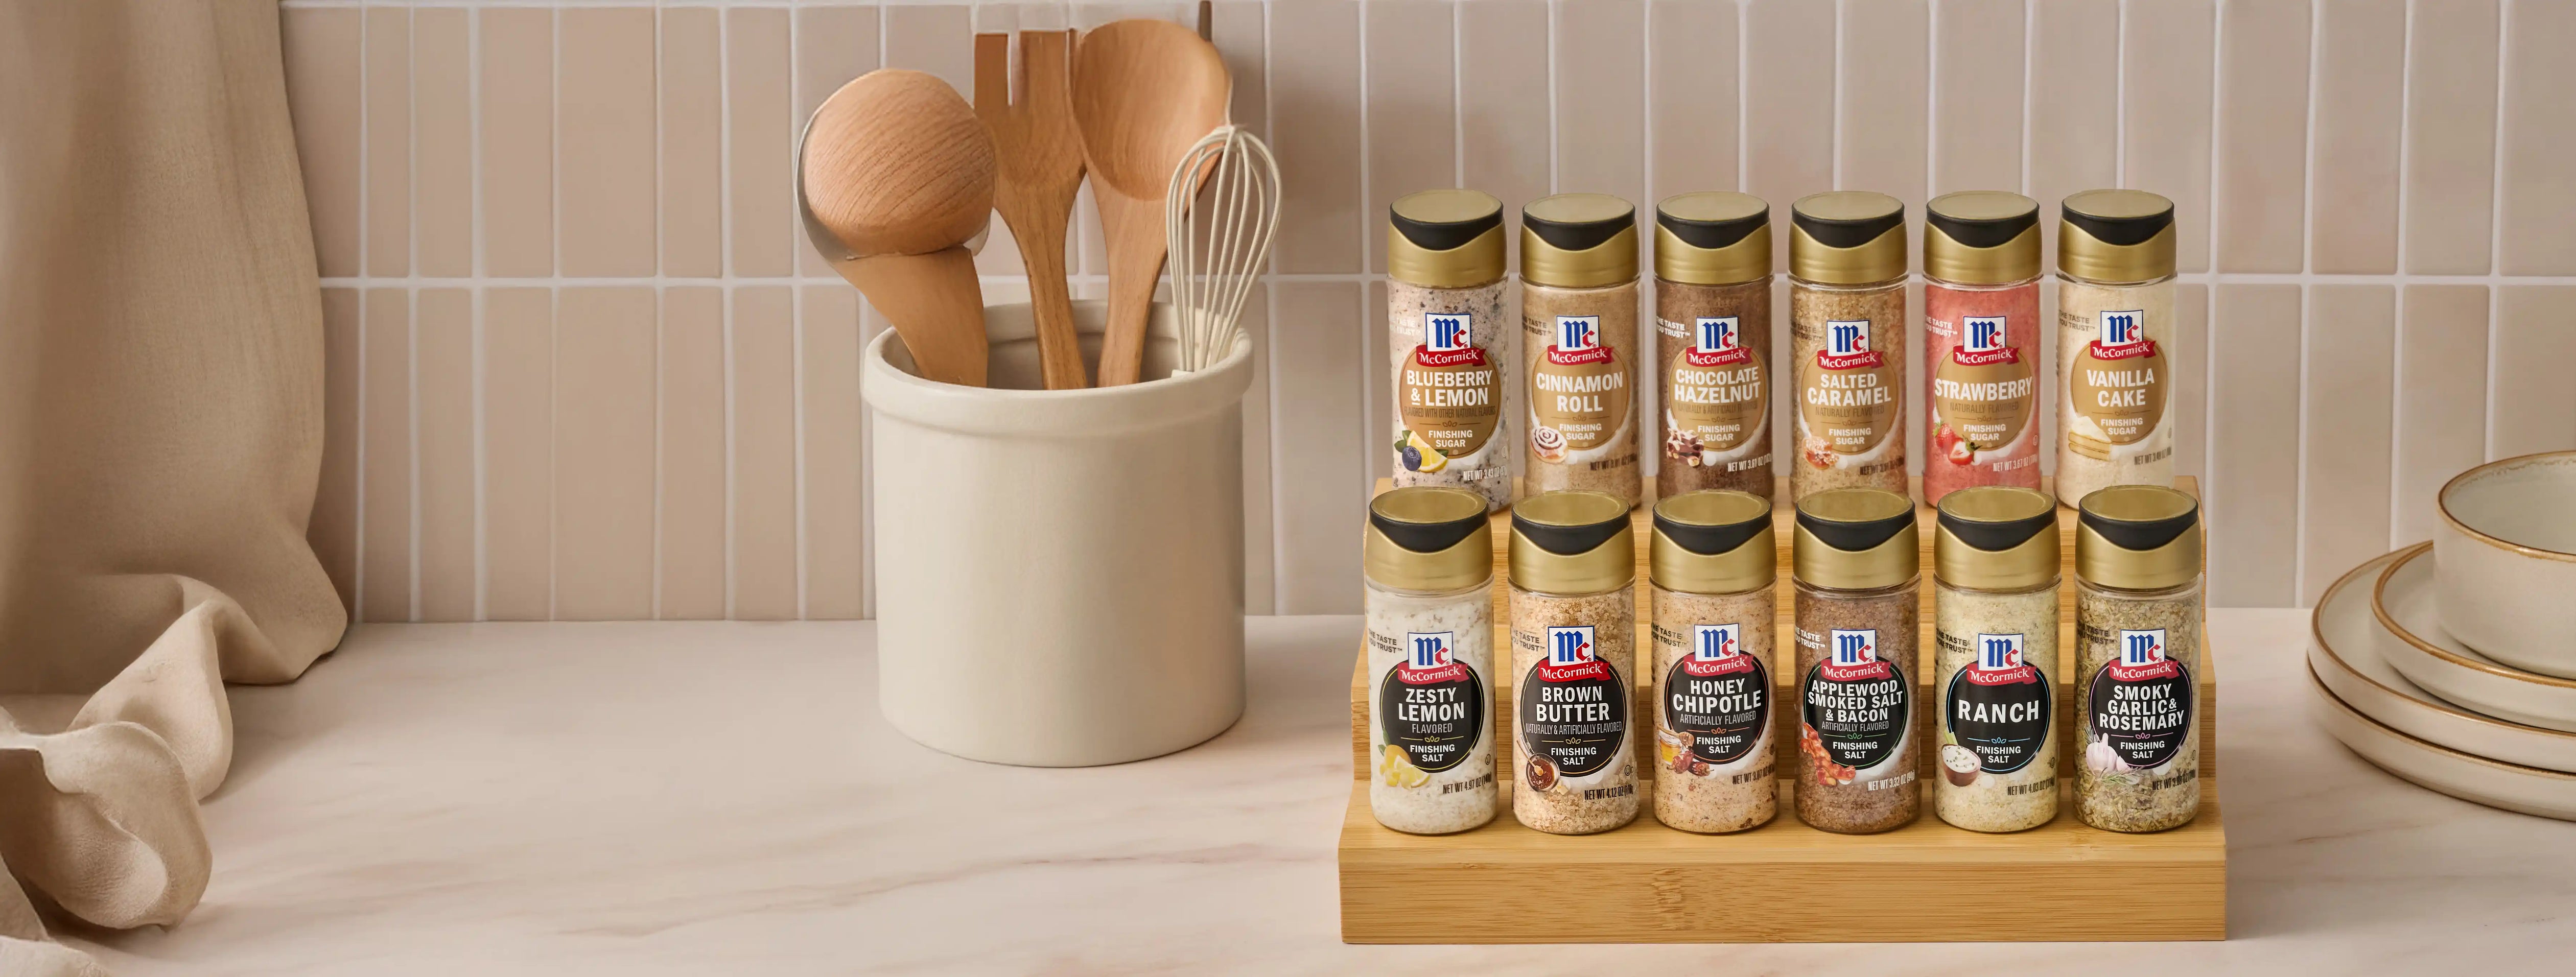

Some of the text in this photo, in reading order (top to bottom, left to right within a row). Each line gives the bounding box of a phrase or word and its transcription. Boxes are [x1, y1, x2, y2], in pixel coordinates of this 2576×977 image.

[1529, 319, 1547, 328] TASTE
[2059, 310, 2090, 323] THE TASTE
[1665, 321, 1685, 329] TASTE
[1933, 319, 1953, 329] TASTE
[1419, 350, 1479, 364] McCormick
[1550, 349, 1607, 363] McCormick
[1689, 350, 1745, 365] McCormick
[1956, 350, 2012, 363] McCormick
[2093, 343, 2149, 358] McCormick
[1820, 353, 1877, 368] McCormick
[1407, 370, 1492, 387] BLUEBERRY
[1536, 372, 1623, 392] CINNAMON
[1676, 367, 1759, 386] CHOCOLATE
[1821, 373, 1877, 389] SALTED
[2087, 368, 2155, 387] VANILLA
[1675, 383, 1761, 403] HAZELNUT
[1935, 376, 2032, 401] STRAWBERRY
[1411, 387, 1488, 407] & LEMON
[1808, 386, 1891, 407] CARAMEL
[2098, 389, 2145, 407] CAKE
[1557, 395, 1603, 413] ROLL
[1678, 404, 1701, 413] NATURALLY
[1707, 404, 1736, 414] ARTIFICIALLY
[1815, 405, 1884, 417] NATURALLY FLAVORED
[1950, 401, 2018, 413] NATURALLY FLAVORED
[1404, 407, 1423, 417] FLAVORED
[1425, 409, 1437, 417] WITH
[1439, 409, 1454, 418] OTHER
[1457, 407, 1477, 418] NATURAL
[1559, 423, 1602, 432] FINISHING
[1698, 424, 1740, 433] FINISHING
[1963, 424, 2006, 433] FINISHING
[2101, 417, 2143, 426] FINISHING
[1829, 427, 1871, 436] FINISHING
[1836, 437, 1865, 445] SUGAR
[1728, 462, 1738, 472] NET
[1739, 461, 1747, 470] WT
[1748, 459, 1757, 469] 3.61
[1758, 457, 1763, 465] OZ
[1993, 462, 2003, 472] NET
[2004, 461, 2012, 470] WT
[2013, 459, 2022, 469] 3.67
[2023, 458, 2028, 467] OZ
[1463, 471, 1473, 481] NET
[1474, 470, 1482, 480] WT
[1484, 468, 1493, 479] 3.43
[1494, 467, 1500, 478] OZ
[1519, 632, 1539, 644] TASTE
[1660, 628, 1682, 639] TASTE
[1801, 630, 1820, 641] TASTE
[2088, 627, 2109, 637] TASTE
[1377, 634, 1397, 646] TASTE
[1946, 634, 1967, 646] TASTE
[1541, 663, 1602, 679] McCormick
[1687, 658, 1747, 674] McCormick
[1823, 664, 1884, 678] McCormick
[2112, 664, 2172, 679] McCormick
[1400, 666, 1461, 681] McCormick
[1970, 668, 2029, 682] McCormick
[1691, 678, 1745, 695] HONEY
[1812, 680, 1898, 696] APPLEWOOD
[2114, 683, 2172, 700] SMOKY
[1406, 687, 1457, 703] ZESTY
[1542, 686, 1602, 703] BROWN
[1673, 689, 1761, 713] CHIPOTLE
[1808, 691, 1903, 709] SMOKED SALT
[1398, 702, 1464, 722] LEMON
[1536, 703, 1609, 722] BUTTER
[1958, 699, 2039, 723] RANCH
[2108, 700, 2167, 715] GARLIC
[1680, 711, 1756, 725] ARTIFICIALLY FLAVORED
[1826, 708, 1888, 723] & BACON
[2100, 710, 2184, 730] ROSEMARY
[1412, 723, 1453, 733] FLAVORED
[1526, 721, 1622, 735] NATURALLY & ARTIFICIALLY FLAVORED
[1821, 721, 1889, 732] ARTIFICIALLY FLAVORED
[1697, 735, 1741, 745] FINISHING
[1833, 742, 1878, 750] FINISHING
[2120, 741, 2165, 750] FINISHING
[1410, 744, 1455, 753] FINISHING
[1551, 747, 1597, 755] FINISHING
[1708, 746, 1730, 754] SALT
[1976, 746, 2021, 754] FINISHING
[1422, 754, 1443, 762] SALT
[1563, 757, 1585, 765] SALT
[1732, 774, 1743, 785] NET
[1744, 773, 1752, 782] WT
[1753, 770, 1762, 781] 3.07
[1868, 781, 1878, 791] NET
[1880, 780, 1889, 791] WT
[1889, 777, 1900, 788] 3.32
[1901, 775, 1906, 784] OZ
[2152, 779, 2171, 790] NET WT
[1443, 779, 1481, 794] NET WT 4.97 OZ
[1584, 785, 1624, 800] NET WT 4.12 OZ
[2007, 786, 2018, 796] NET
[2019, 785, 2027, 795] WT
[2029, 783, 2039, 793] 4.03
[2040, 781, 2045, 791] OZ
